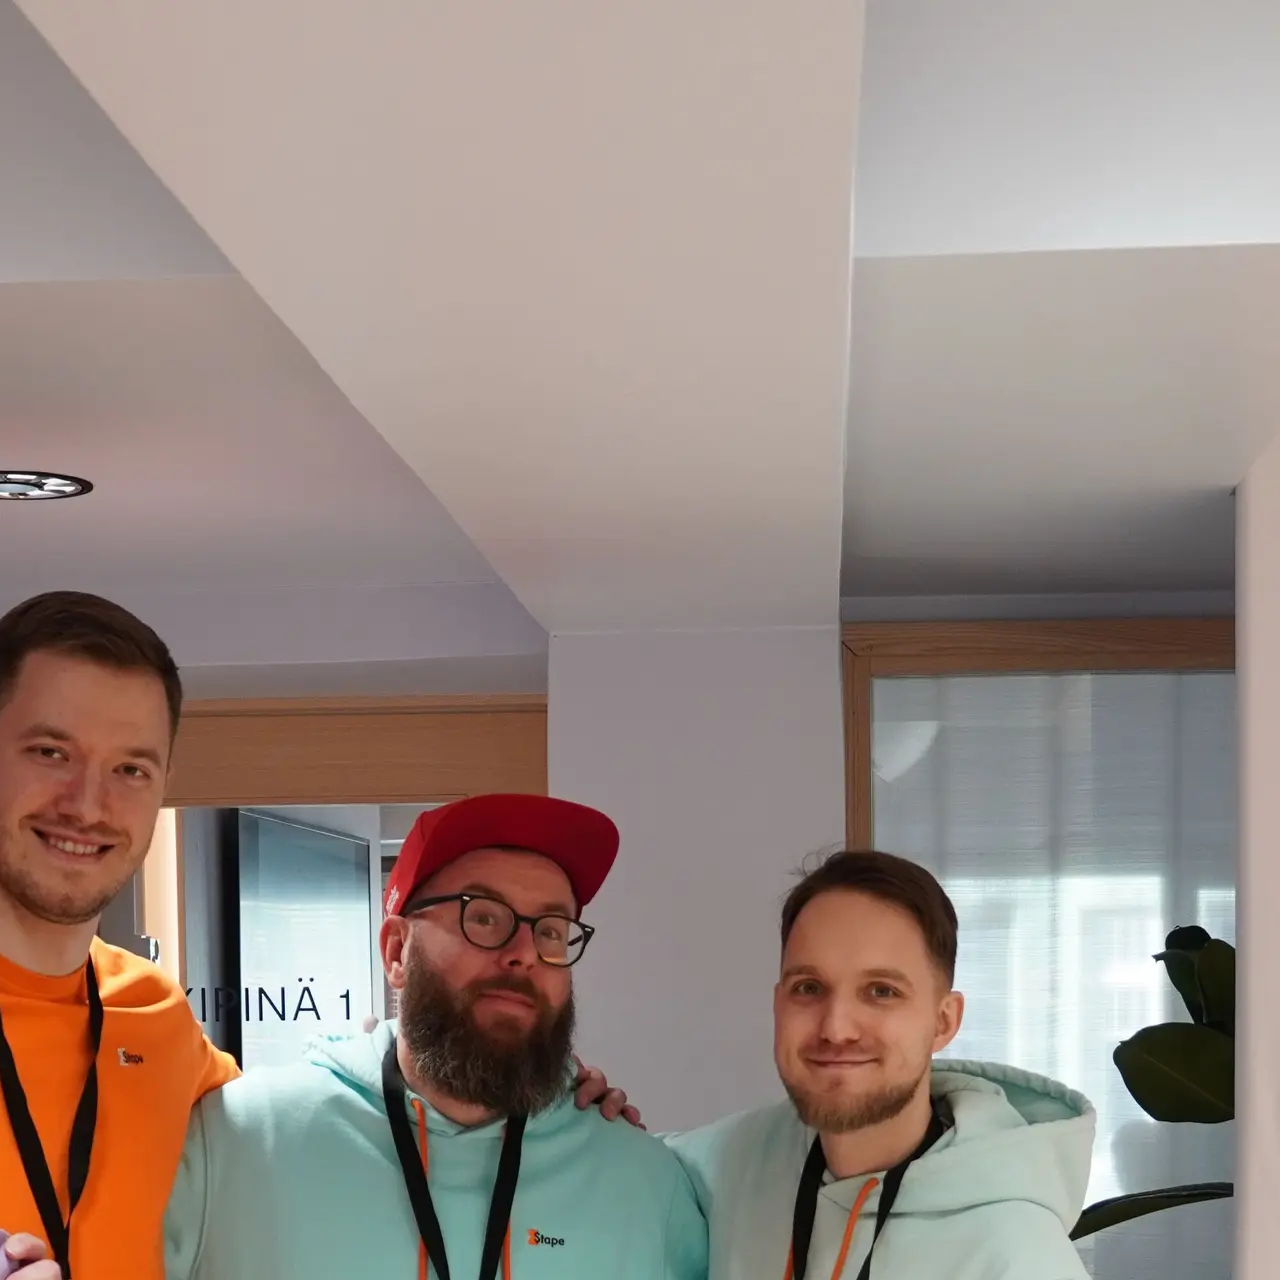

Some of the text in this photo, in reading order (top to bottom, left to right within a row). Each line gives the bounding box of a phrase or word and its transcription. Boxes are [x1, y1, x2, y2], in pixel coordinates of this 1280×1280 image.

[185, 976, 351, 1023] IPINÄ 1
[532, 1230, 565, 1248] Stape
